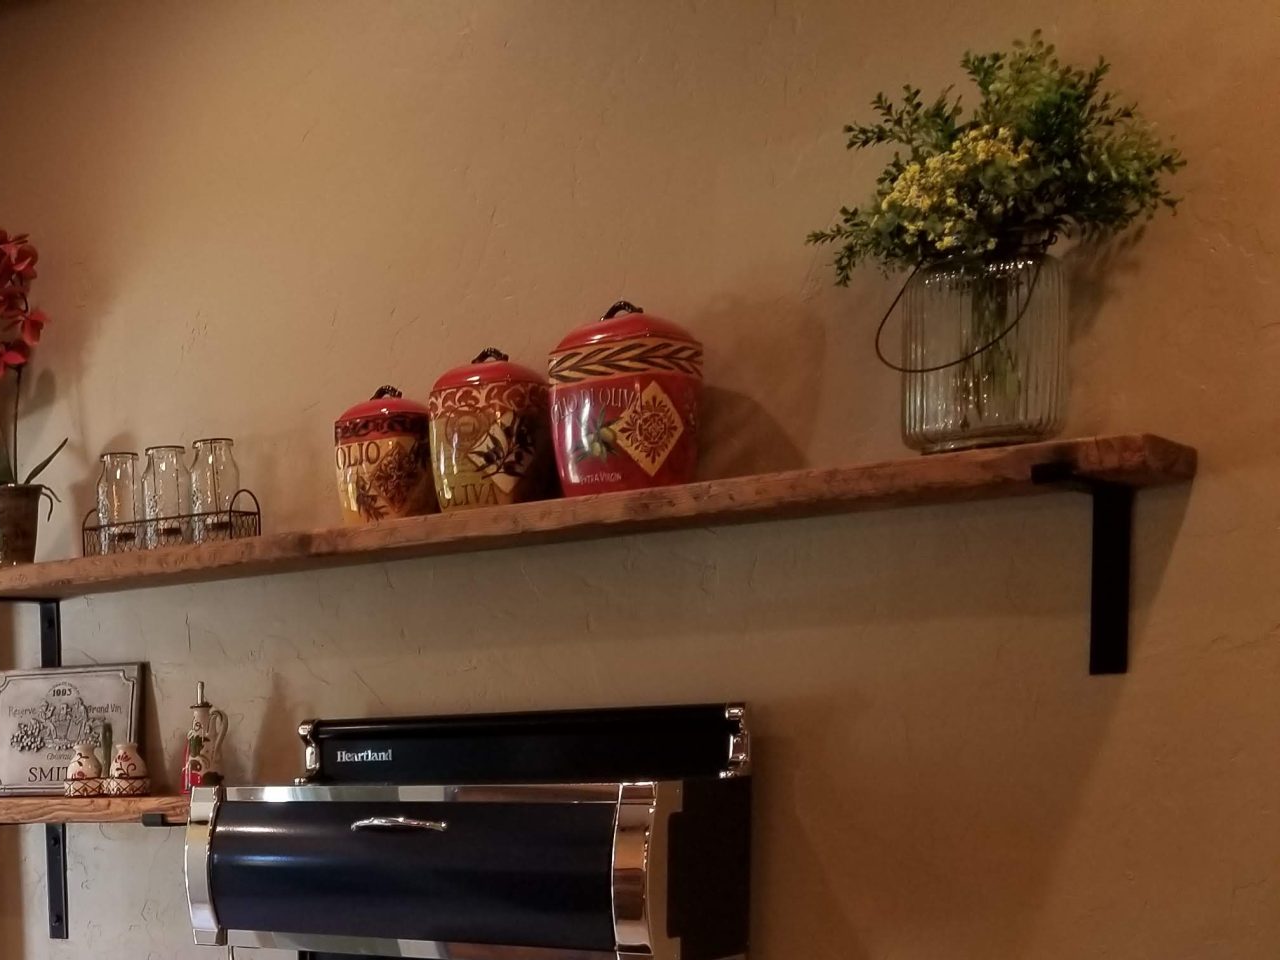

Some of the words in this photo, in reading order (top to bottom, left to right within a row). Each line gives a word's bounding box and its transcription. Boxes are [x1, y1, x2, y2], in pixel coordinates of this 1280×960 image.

[599, 386, 641, 412] OLIVA
[335, 441, 381, 471] OLIO
[438, 483, 499, 509] OLIVA
[336, 748, 393, 763] Heartland
